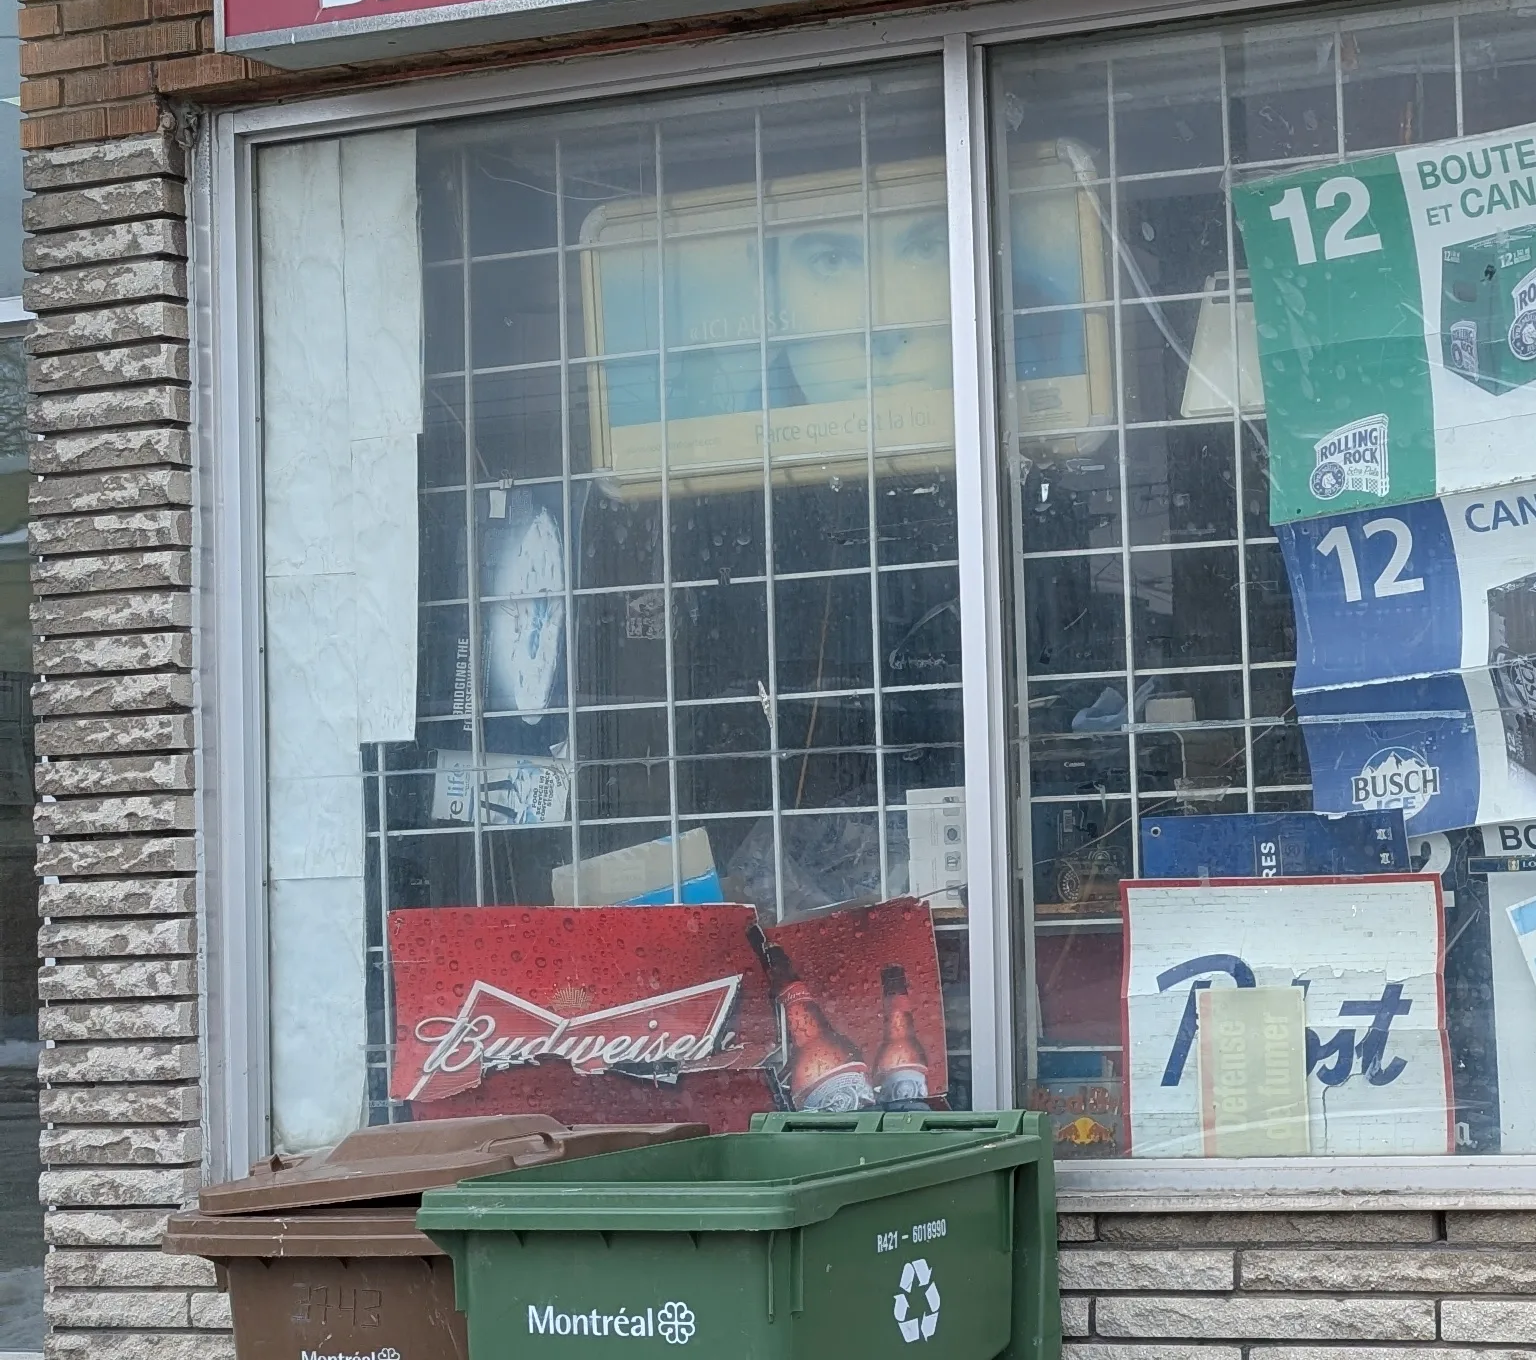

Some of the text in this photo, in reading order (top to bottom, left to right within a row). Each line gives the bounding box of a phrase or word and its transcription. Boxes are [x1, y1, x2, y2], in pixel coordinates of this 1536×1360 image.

[1269, 176, 1383, 266] 12
[1426, 204, 1453, 227] ET
[806, 420, 839, 445] que
[889, 411, 905, 429] la
[1320, 428, 1379, 462] ROLLING
[1343, 447, 1379, 466] ROCK
[1316, 517, 1425, 603] 12
[456, 637, 469, 660] THE
[1353, 765, 1440, 805] BUSCH
[877, 1230, 898, 1253] R421
[912, 1218, 947, 1243] 6018990
[528, 1305, 654, 1338] Montréal
